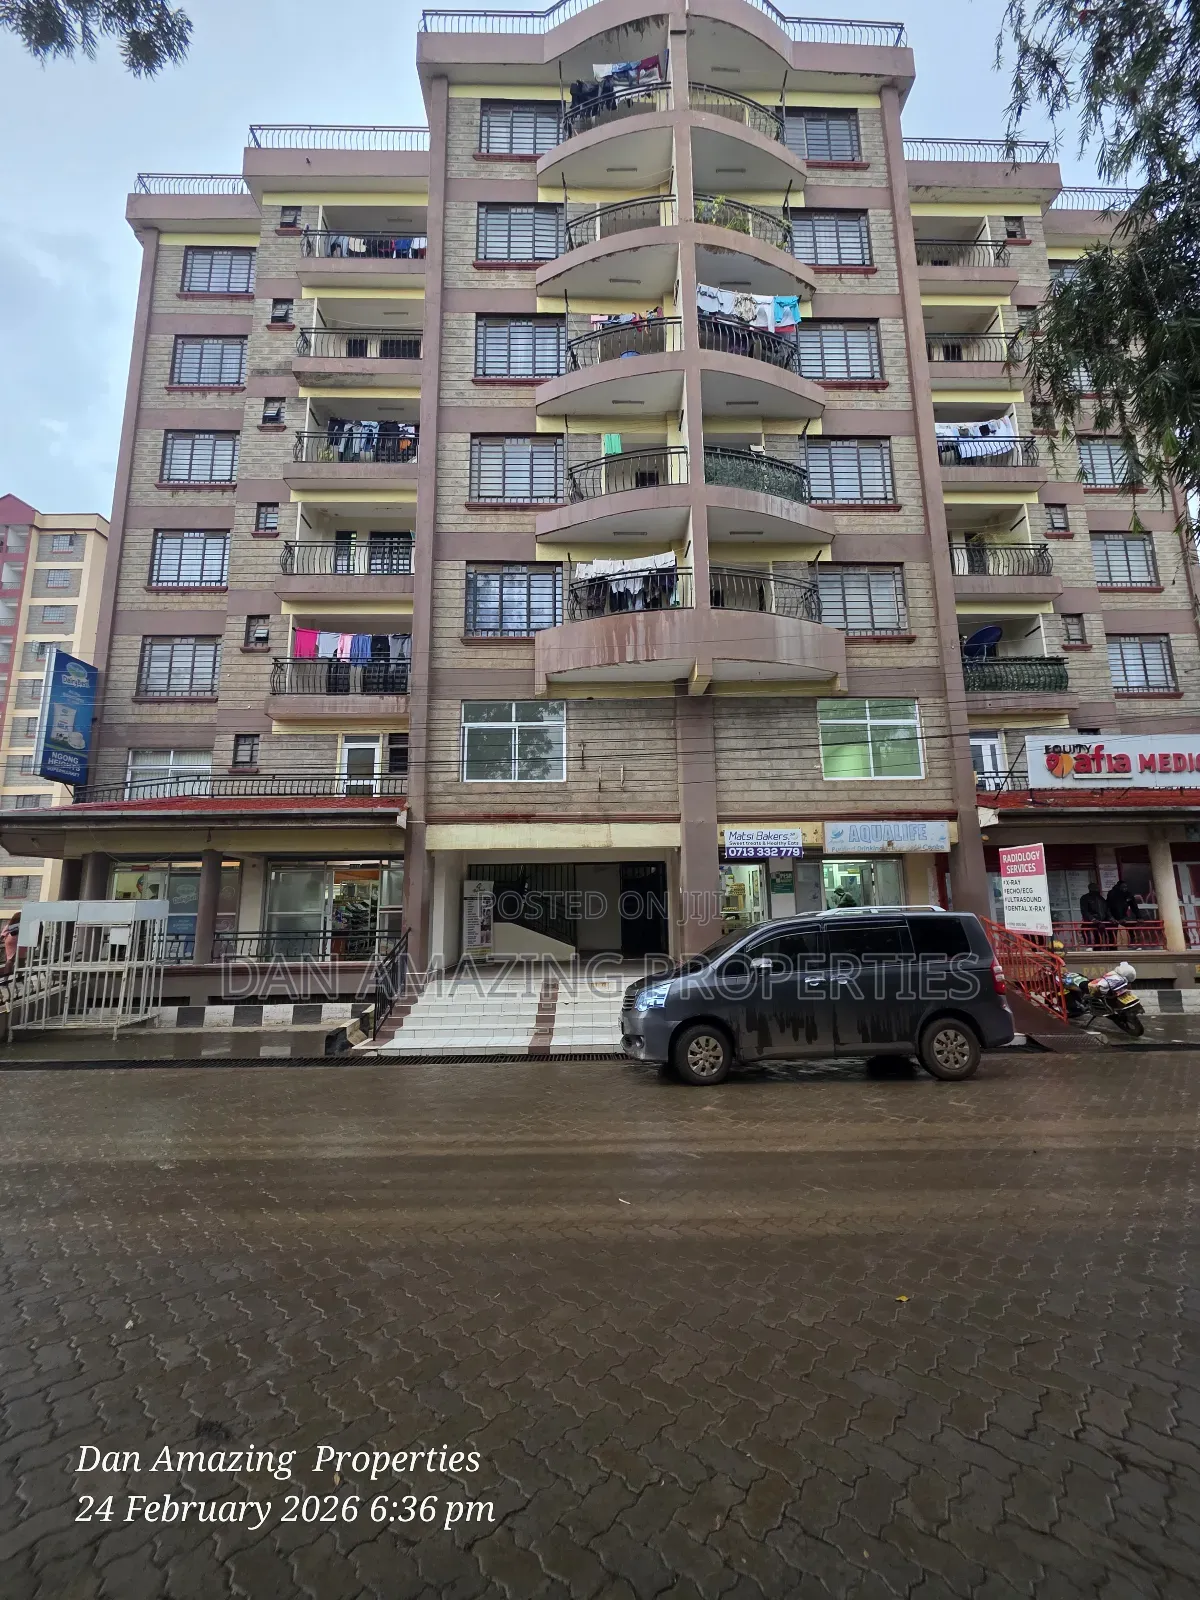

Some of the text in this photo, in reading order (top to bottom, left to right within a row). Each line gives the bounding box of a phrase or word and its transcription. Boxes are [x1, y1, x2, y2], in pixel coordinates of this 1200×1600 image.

[1044, 744, 1092, 754] EQUITY
[51, 751, 79, 765] NGONG
[1073, 744, 1132, 773] afia
[728, 831, 754, 841] Matsi
[848, 823, 928, 843] AQUALIFE
[728, 848, 800, 856] 0713 332 779
[1002, 850, 1041, 863] RADIOLOGY
[1006, 863, 1037, 874] SERVICES
